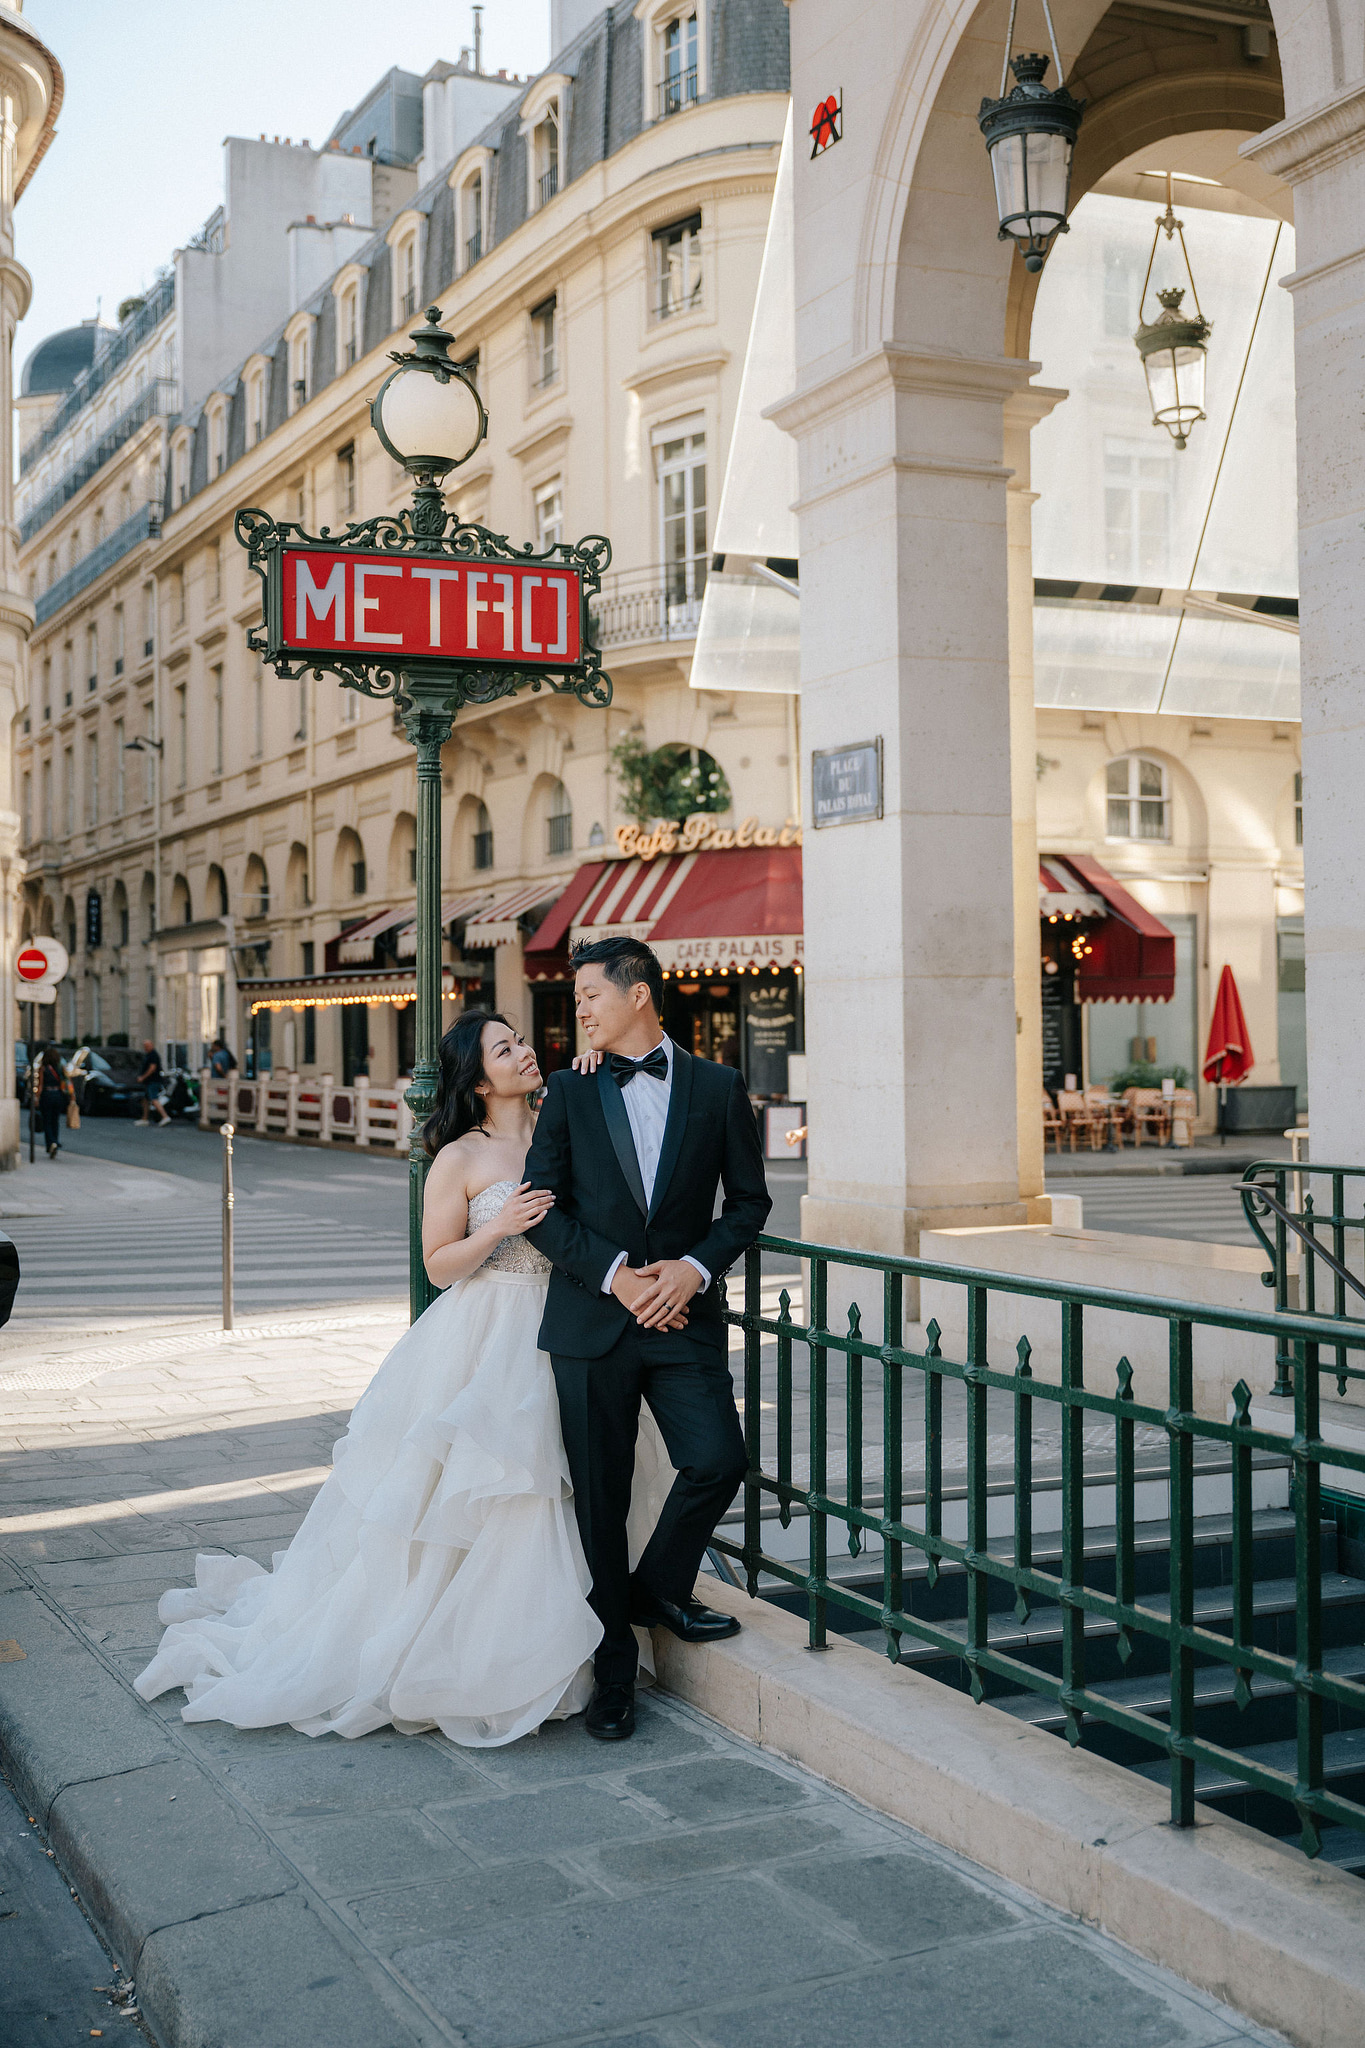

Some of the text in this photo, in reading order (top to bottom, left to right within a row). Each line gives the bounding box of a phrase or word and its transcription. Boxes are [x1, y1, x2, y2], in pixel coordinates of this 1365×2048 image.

[295, 558, 567, 655] METRO
[830, 757, 860, 775] PLACE
[838, 777, 851, 792] DU
[818, 797, 846, 814] PALAIS
[717, 940, 783, 957] PALAIS
